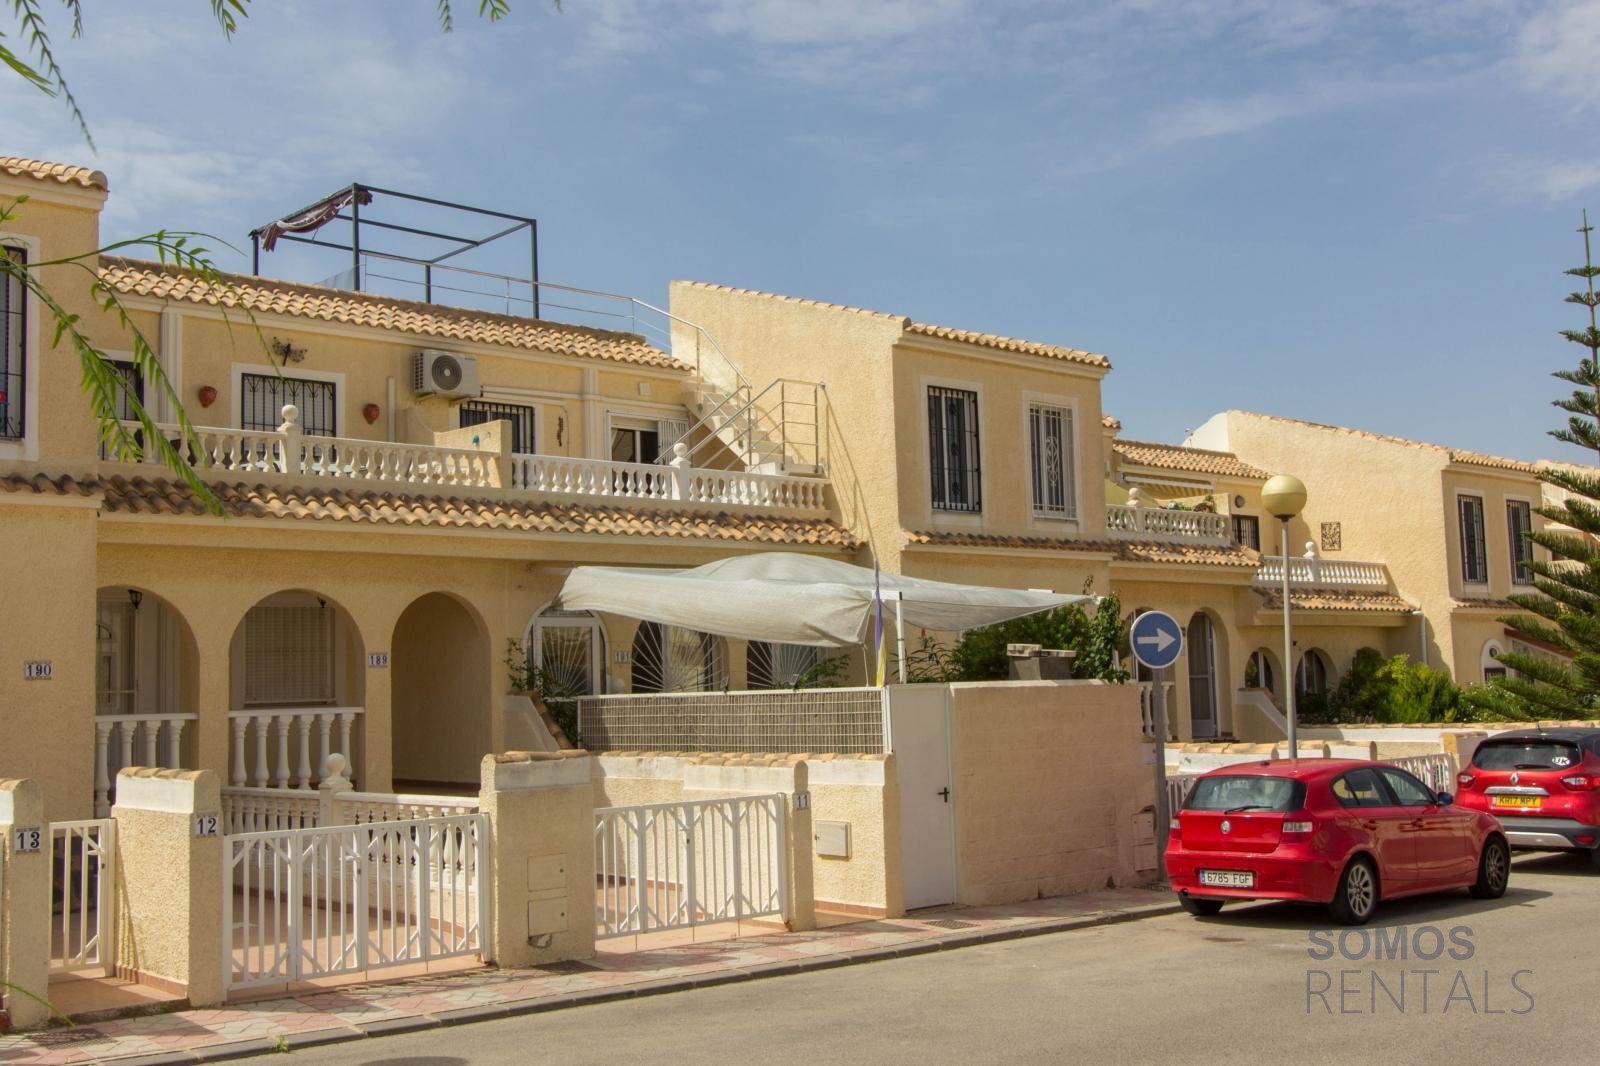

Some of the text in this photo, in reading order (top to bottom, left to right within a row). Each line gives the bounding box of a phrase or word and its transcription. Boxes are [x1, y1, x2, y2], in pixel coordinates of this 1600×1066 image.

[27, 664, 52, 677] 190
[197, 817, 217, 834] 12
[17, 831, 40, 849] 13
[1207, 872, 1251, 884] 6785 FGF
